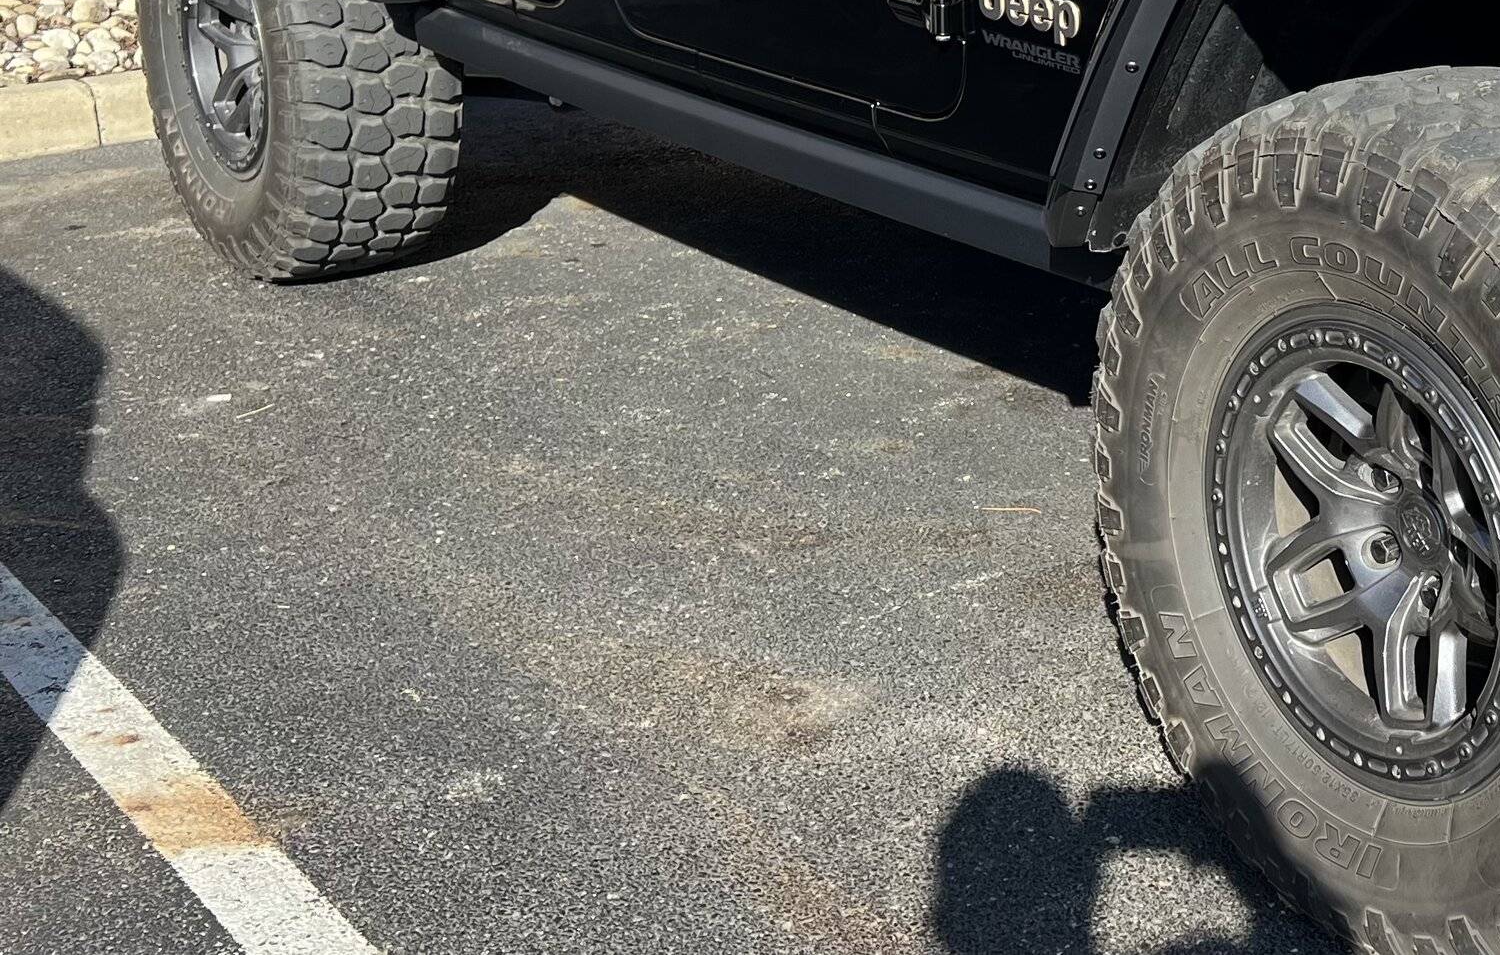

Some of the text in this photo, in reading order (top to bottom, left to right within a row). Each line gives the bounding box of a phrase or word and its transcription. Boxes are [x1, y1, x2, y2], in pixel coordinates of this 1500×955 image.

[982, 29, 1081, 68] WRANGLER
[1012, 51, 1081, 74] UNLIMITED
[1192, 241, 1280, 319] ALL
[1139, 376, 1159, 471] IRONMAN
[1158, 610, 1384, 879] IRONMAN
